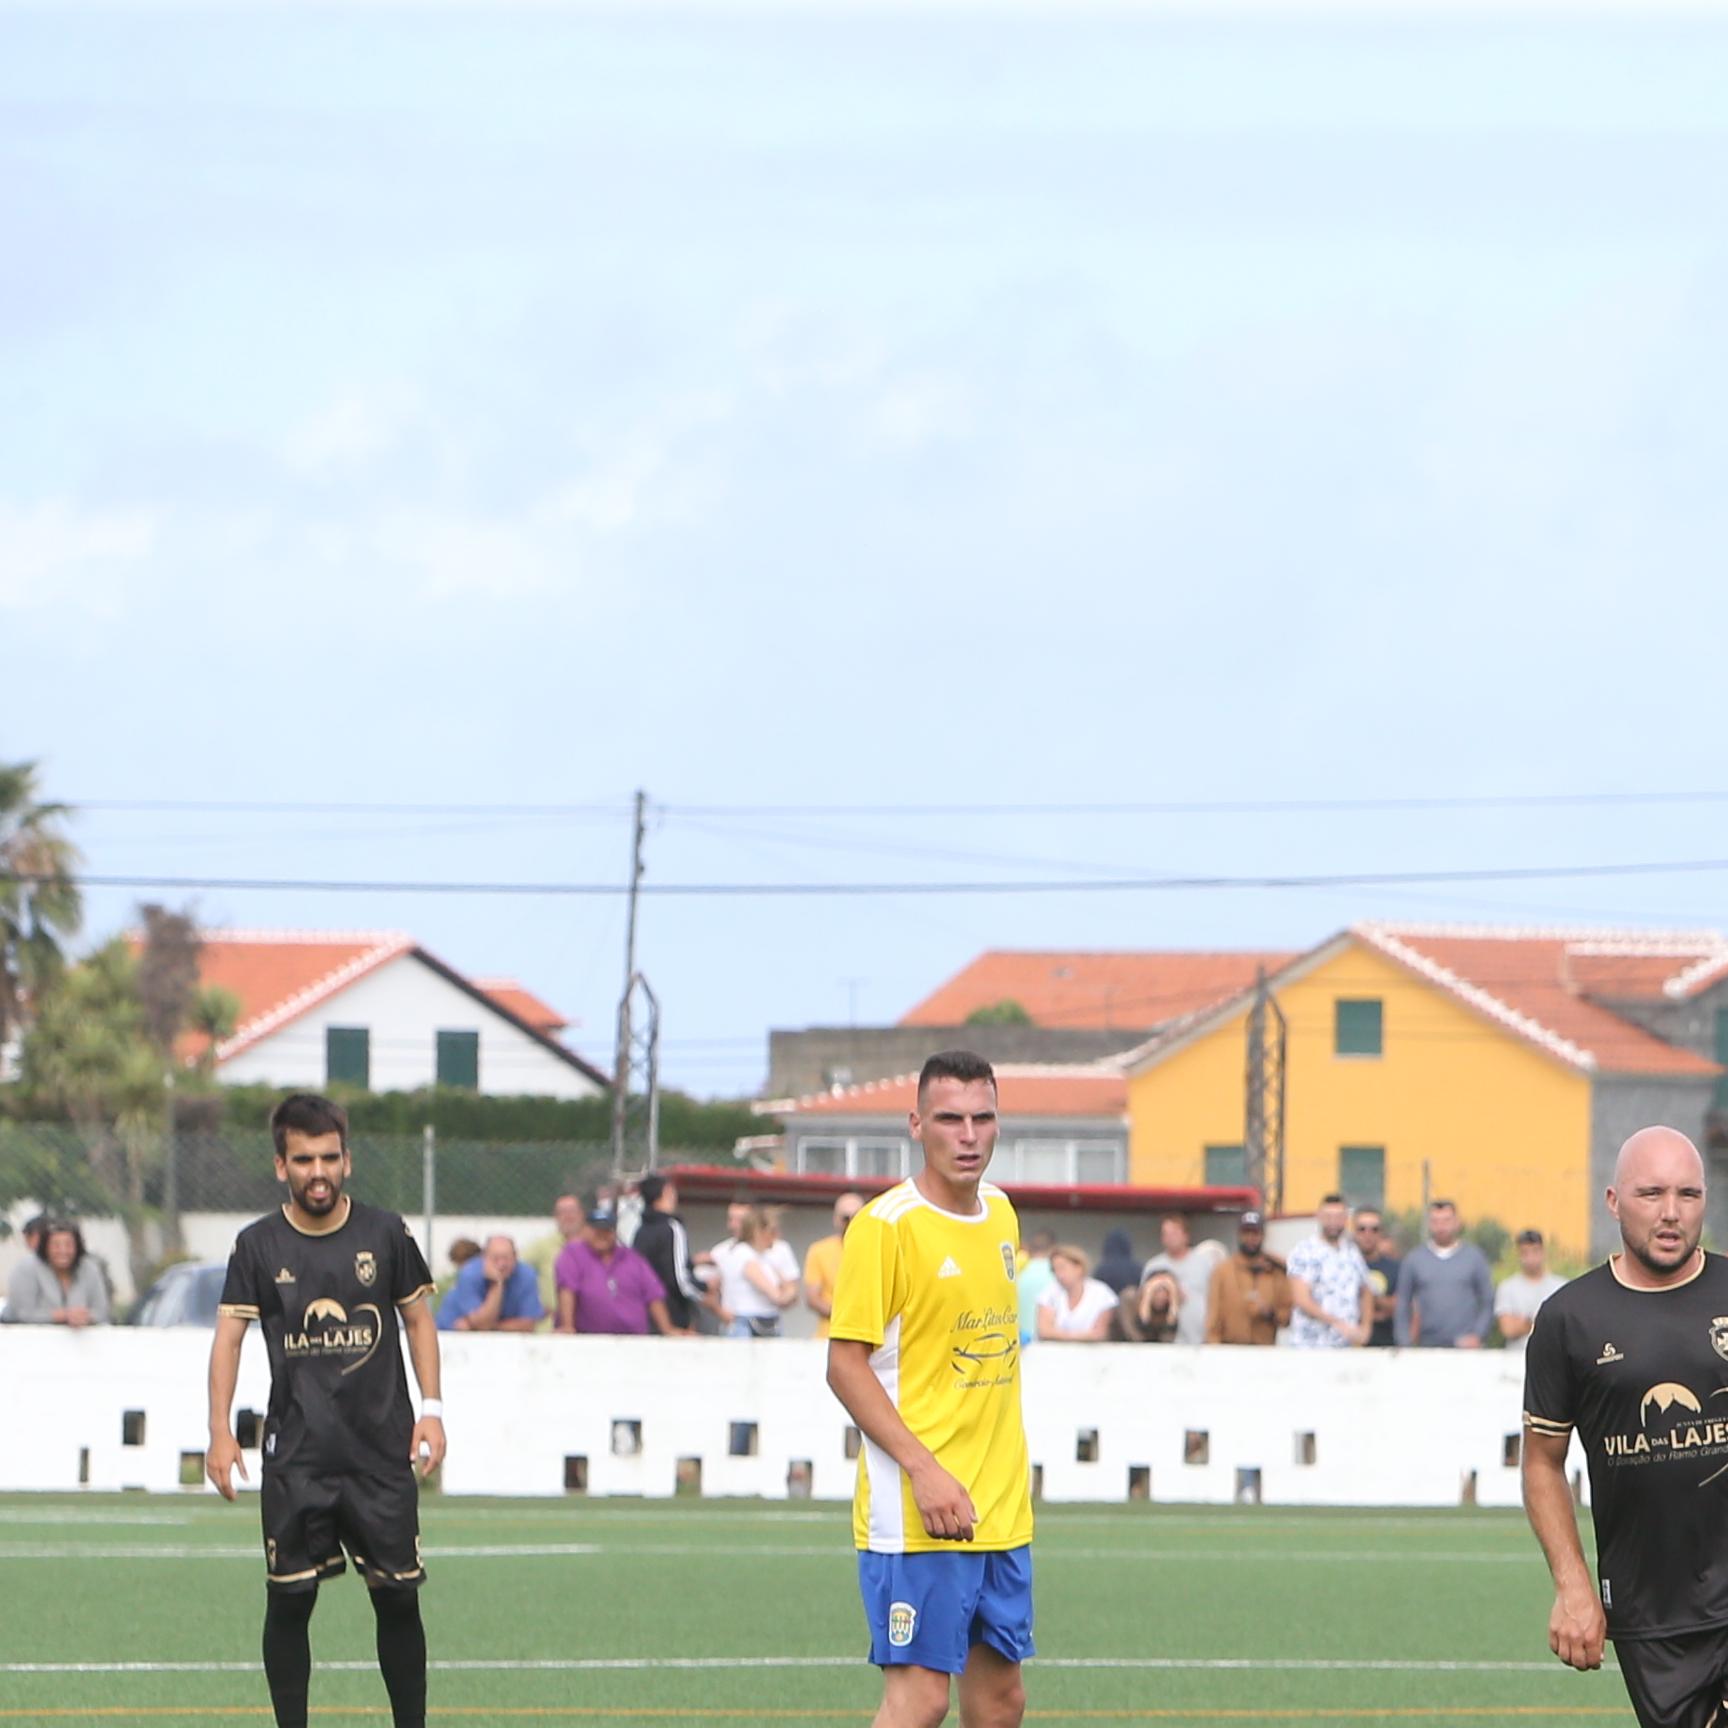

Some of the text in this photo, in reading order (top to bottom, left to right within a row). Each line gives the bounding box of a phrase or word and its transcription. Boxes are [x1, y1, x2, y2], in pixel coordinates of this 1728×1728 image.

[323, 1328, 373, 1348] LAJES
[1603, 1432, 1651, 1457] VILA
[1651, 1437, 1670, 1447] DAS
